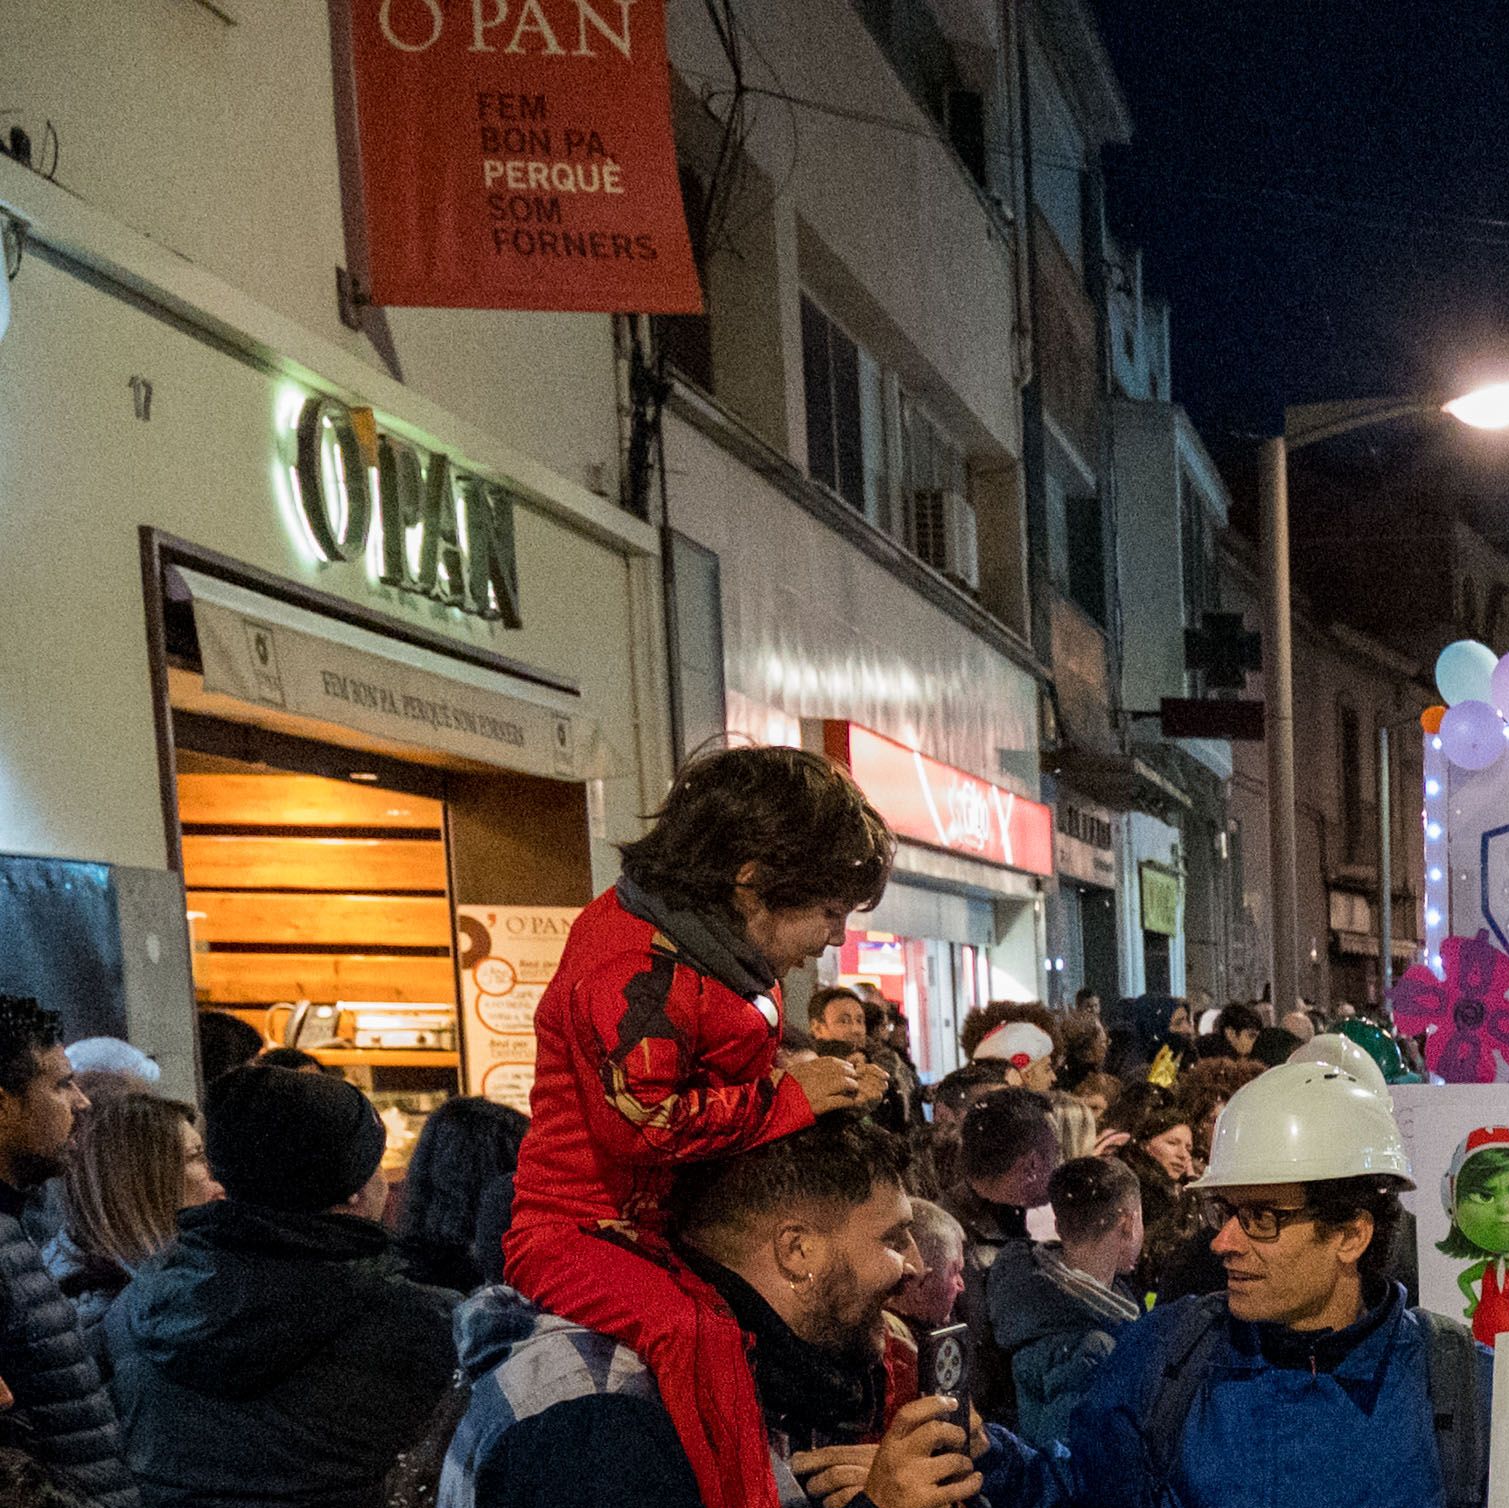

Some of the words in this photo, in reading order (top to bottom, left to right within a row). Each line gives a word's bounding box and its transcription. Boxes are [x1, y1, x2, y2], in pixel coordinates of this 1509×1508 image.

[477, 91, 547, 121] FEM
[481, 127, 551, 155] BON
[483, 158, 624, 194] PERQUÈ
[488, 193, 563, 224] SOM
[492, 228, 658, 261] FORNERS
[128, 374, 153, 422] 17
